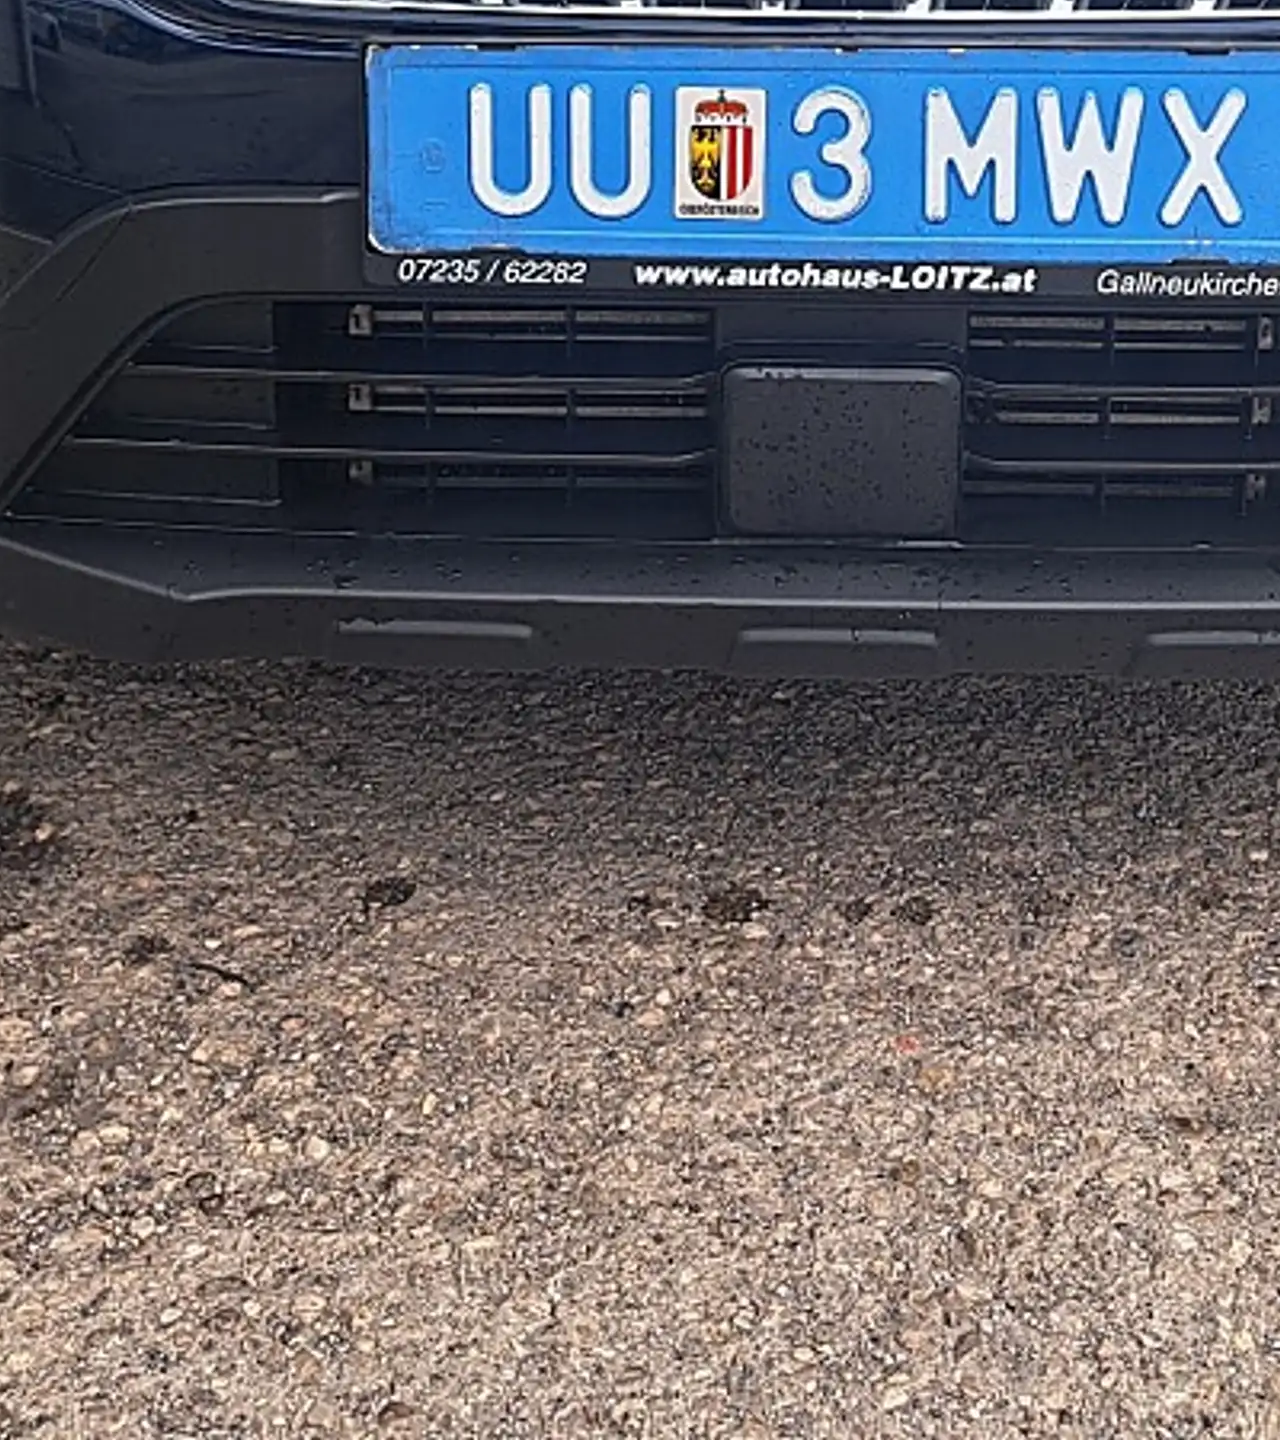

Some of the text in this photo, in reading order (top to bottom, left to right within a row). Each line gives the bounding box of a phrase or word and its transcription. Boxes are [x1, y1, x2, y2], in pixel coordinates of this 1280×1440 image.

[469, 82, 1247, 227] UU 3 MWX
[399, 259, 480, 282] 07235
[504, 260, 587, 283] 62282
[634, 263, 1038, 292] www.autohaus-LOITZ.at
